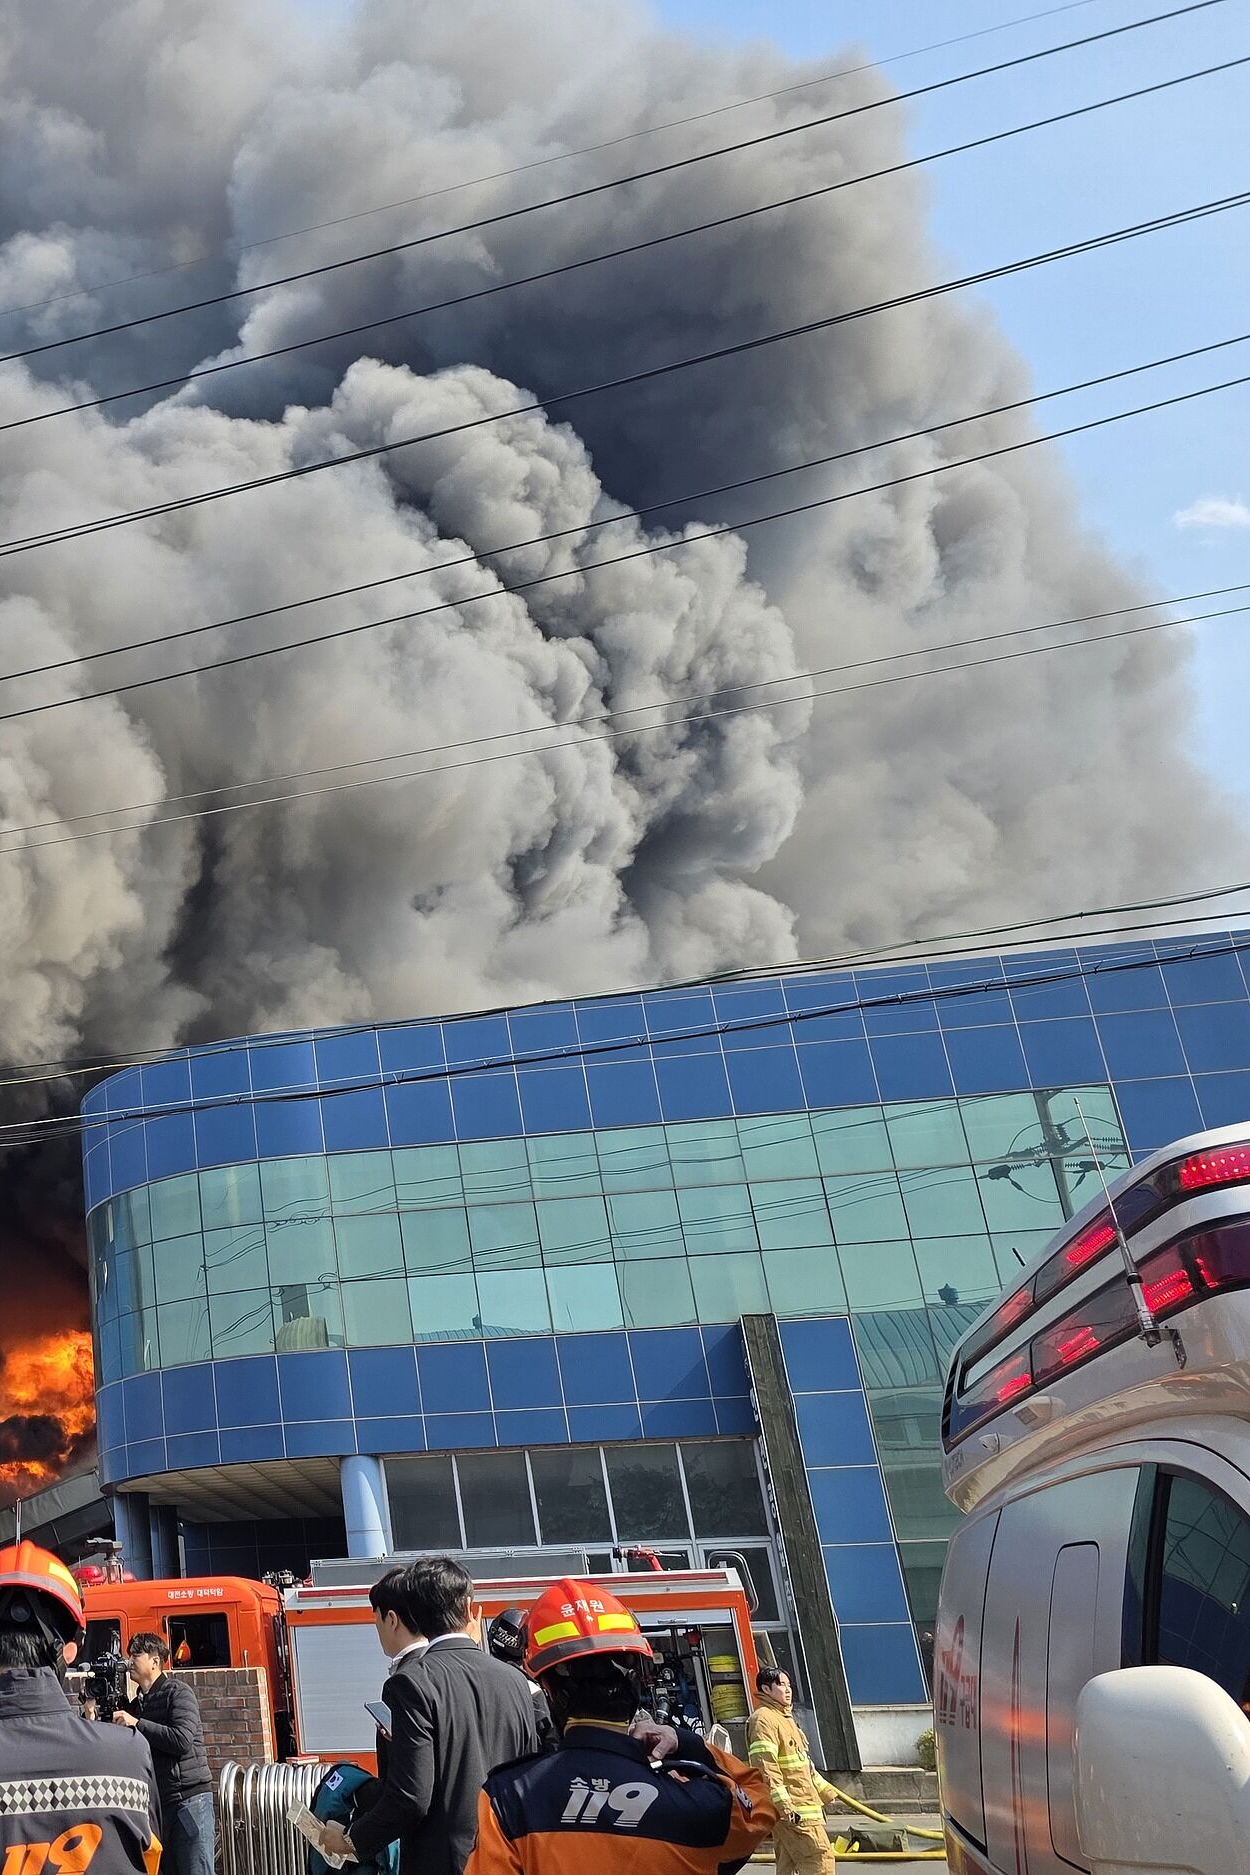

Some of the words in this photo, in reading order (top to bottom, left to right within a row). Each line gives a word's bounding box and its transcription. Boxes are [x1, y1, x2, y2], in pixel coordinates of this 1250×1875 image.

[167, 1590, 193, 1599] 대전소방
[561, 1599, 605, 1617] 윤재원
[570, 1777, 610, 1791] 소방
[560, 1782, 659, 1827] 119
[1, 1823, 103, 1875] 119
